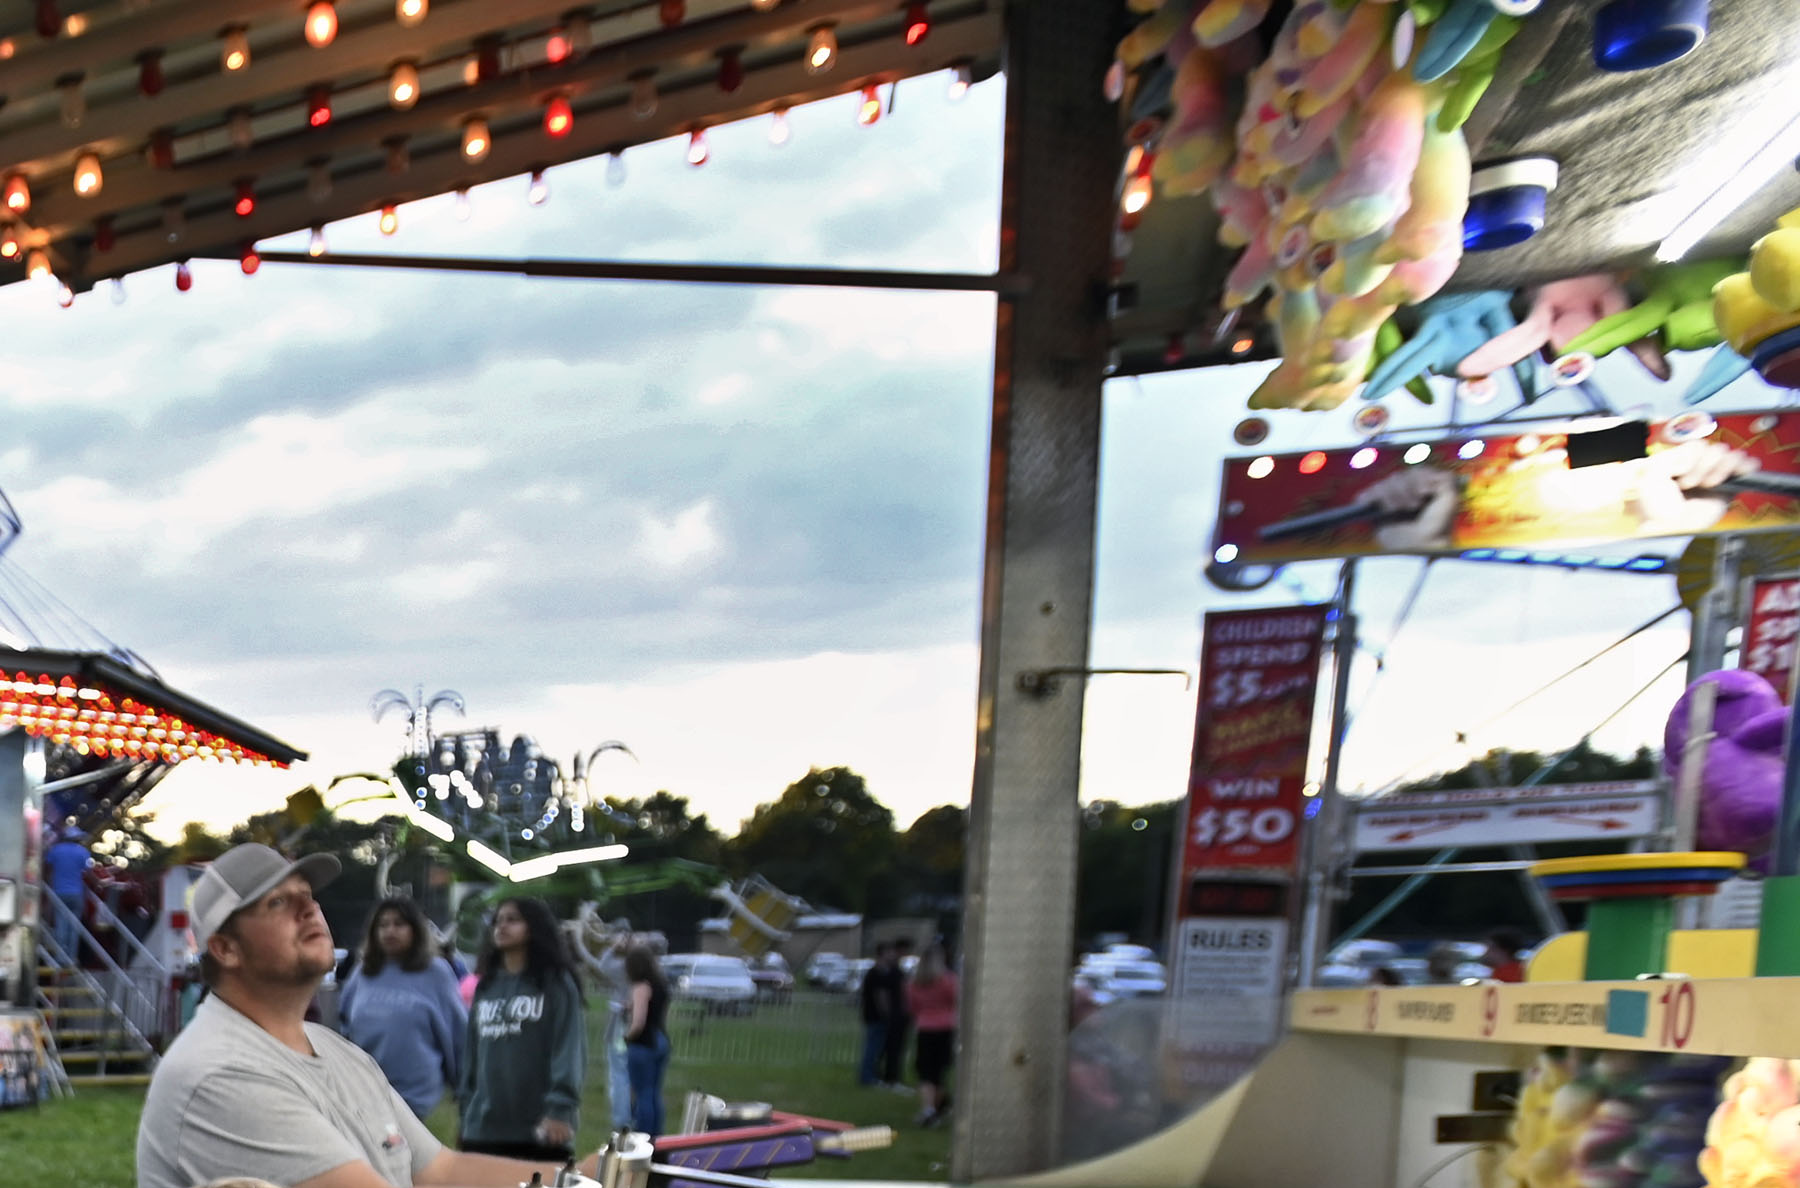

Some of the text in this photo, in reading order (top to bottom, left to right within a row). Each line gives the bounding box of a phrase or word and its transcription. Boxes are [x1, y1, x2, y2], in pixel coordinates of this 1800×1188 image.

[1212, 616, 1318, 644] CHILDREN
[1215, 642, 1310, 667] SPEND
[1212, 671, 1264, 707] $5
[1211, 777, 1280, 799] WIN
[1193, 806, 1295, 848] $50
[1189, 928, 1273, 950] RULES
[509, 993, 545, 1022] YOU
[1659, 981, 1695, 1049] 10
